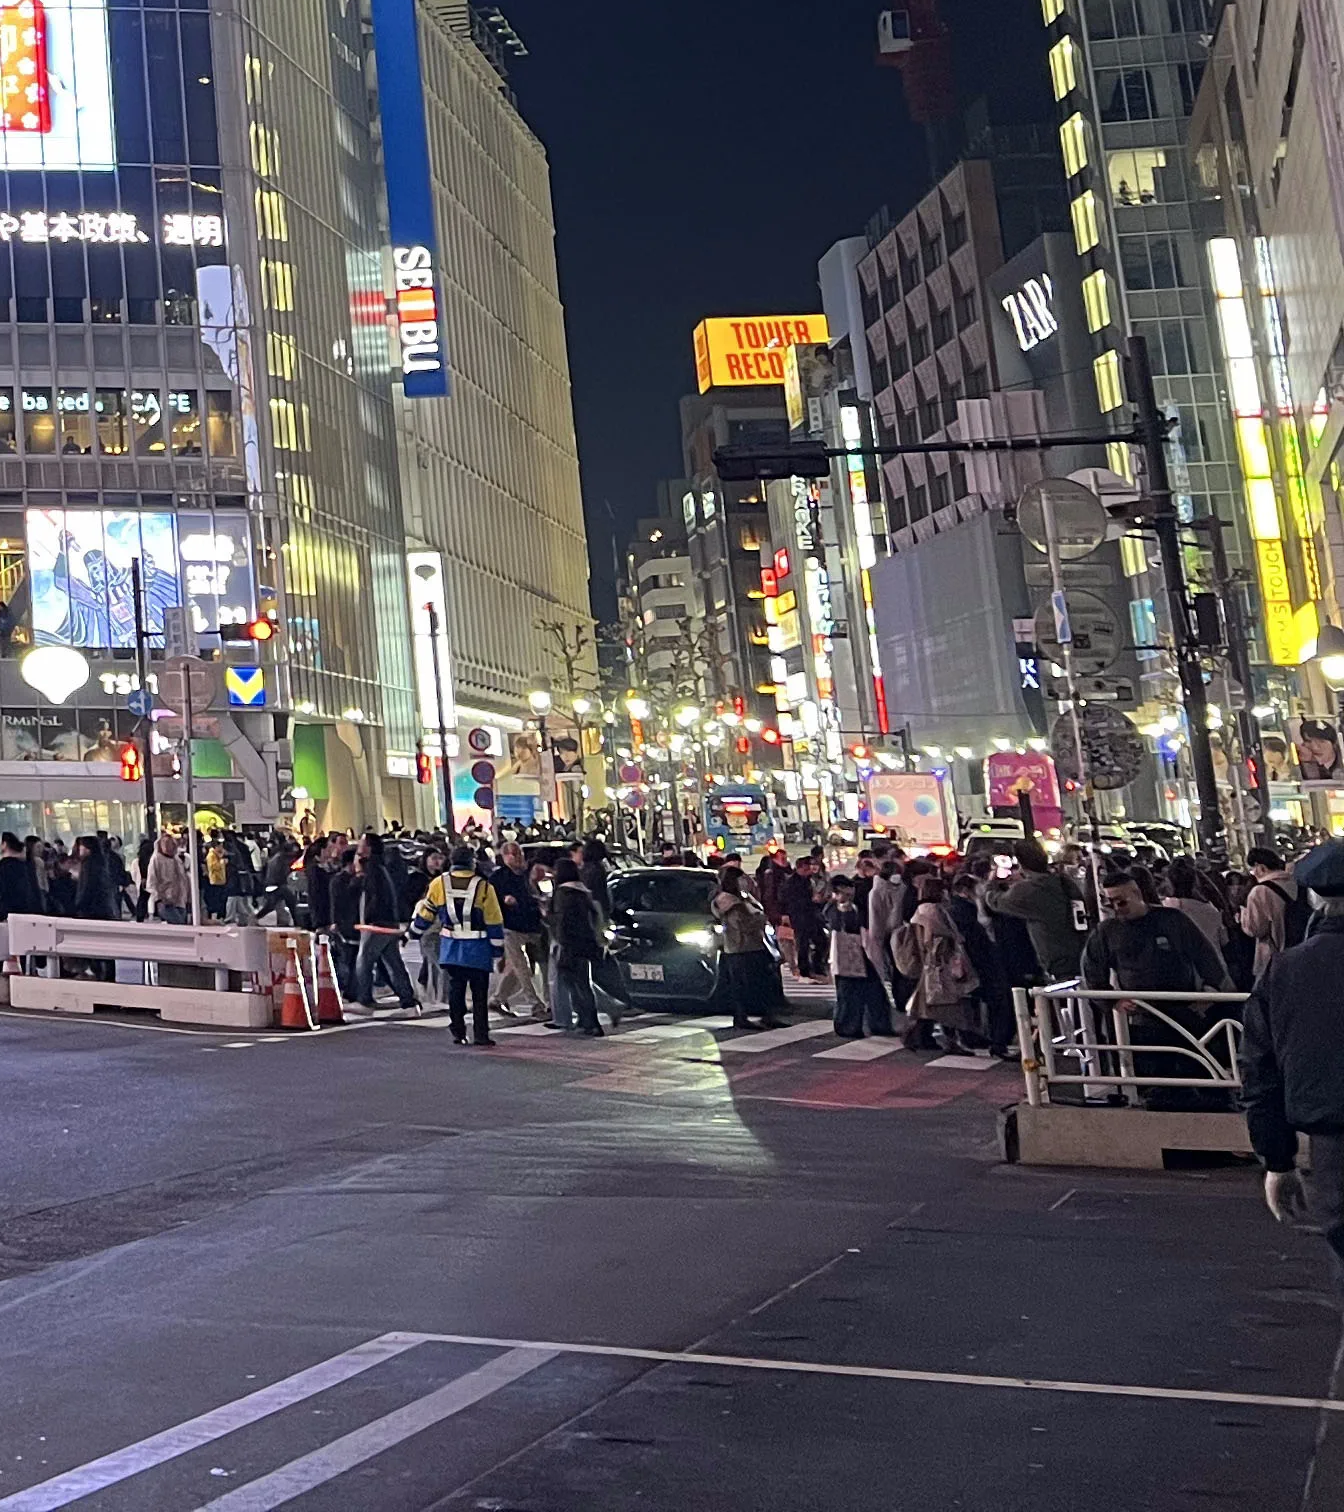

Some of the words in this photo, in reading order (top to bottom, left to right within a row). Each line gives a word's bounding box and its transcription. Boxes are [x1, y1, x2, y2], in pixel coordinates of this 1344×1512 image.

[390, 244, 442, 375] SEIBU
[730, 320, 811, 349] TOWER
[726, 354, 785, 380] RECO
[1265, 538, 1289, 601] TOUCH
